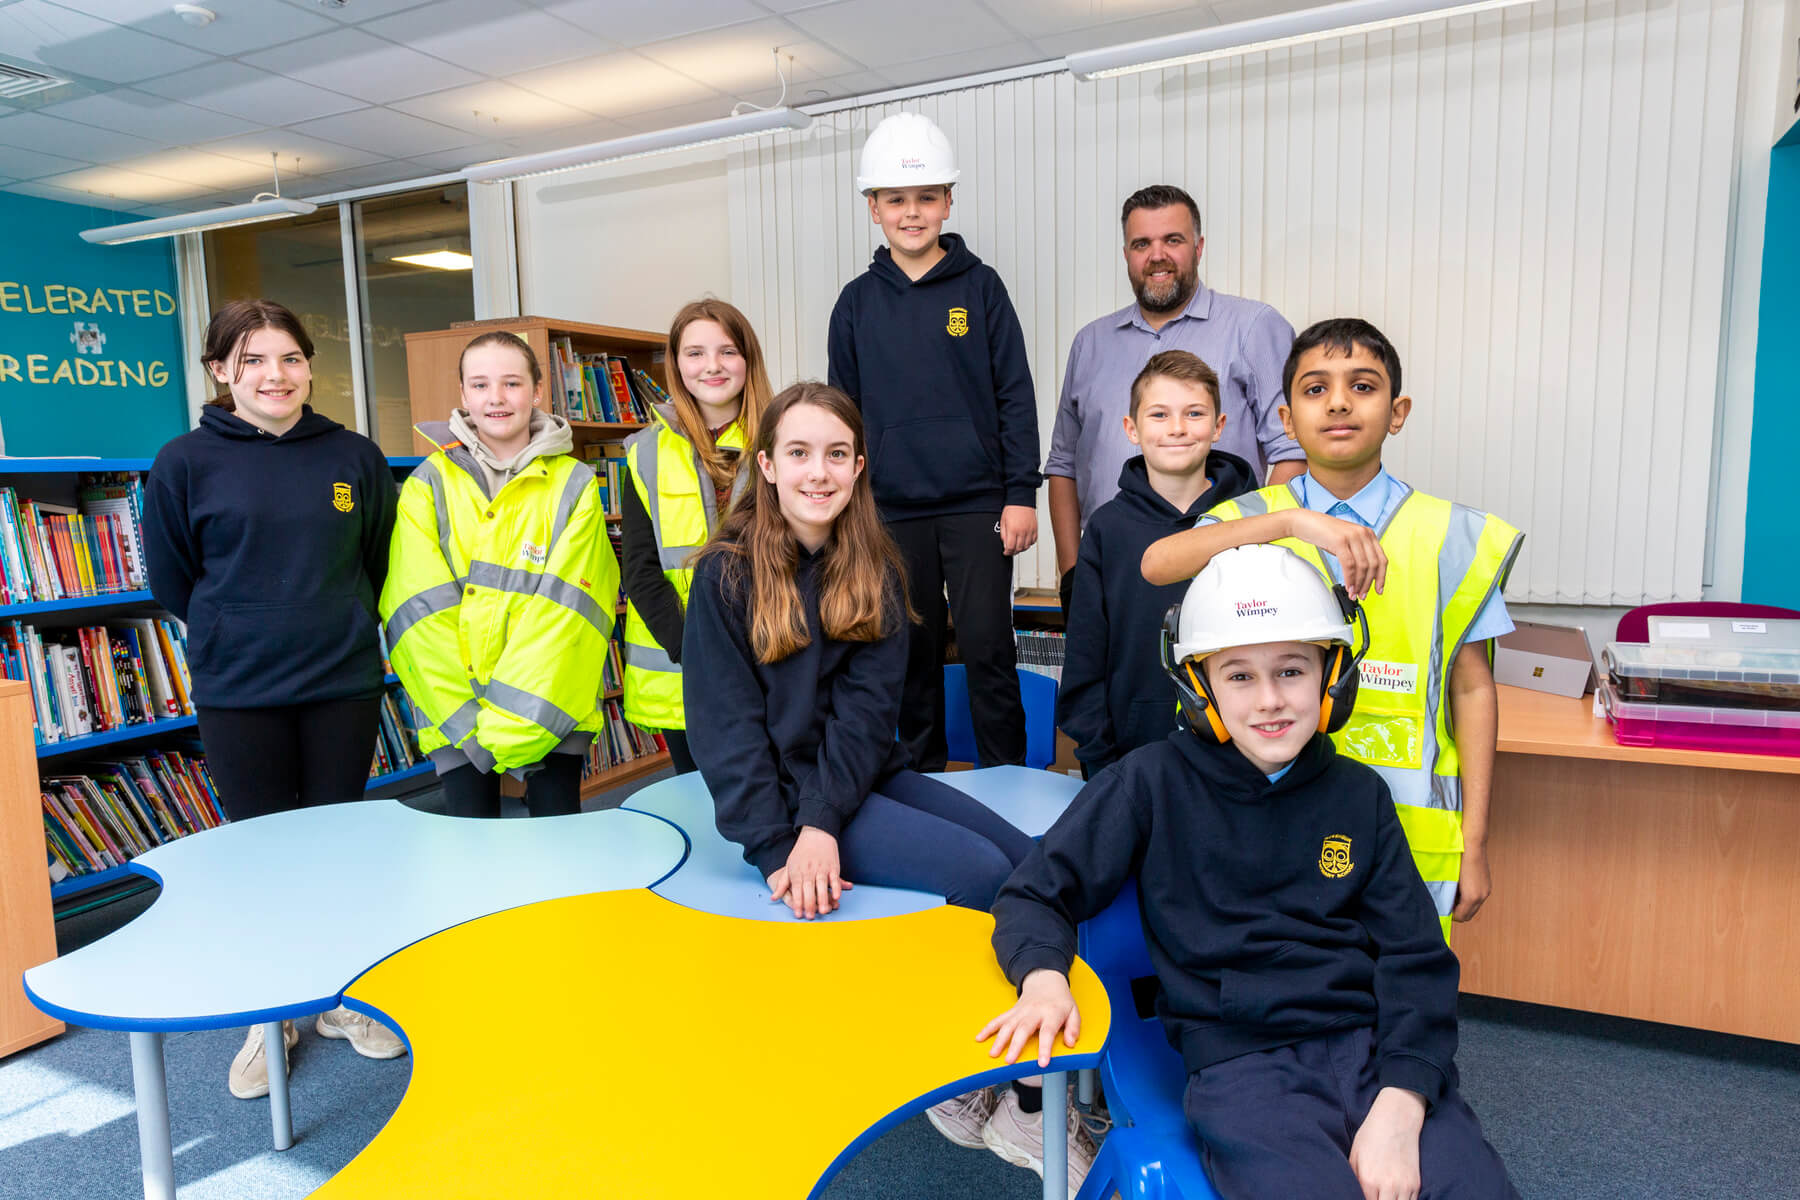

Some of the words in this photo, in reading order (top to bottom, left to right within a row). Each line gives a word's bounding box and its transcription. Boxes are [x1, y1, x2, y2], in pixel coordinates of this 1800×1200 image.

[0, 281, 176, 317] ELERATED
[0, 354, 169, 387] READING
[1235, 599, 1267, 610] Taylor
[1236, 607, 1278, 617] Wimpey
[1359, 662, 1403, 677] Taylor
[1360, 673, 1415, 691] Wimpey
